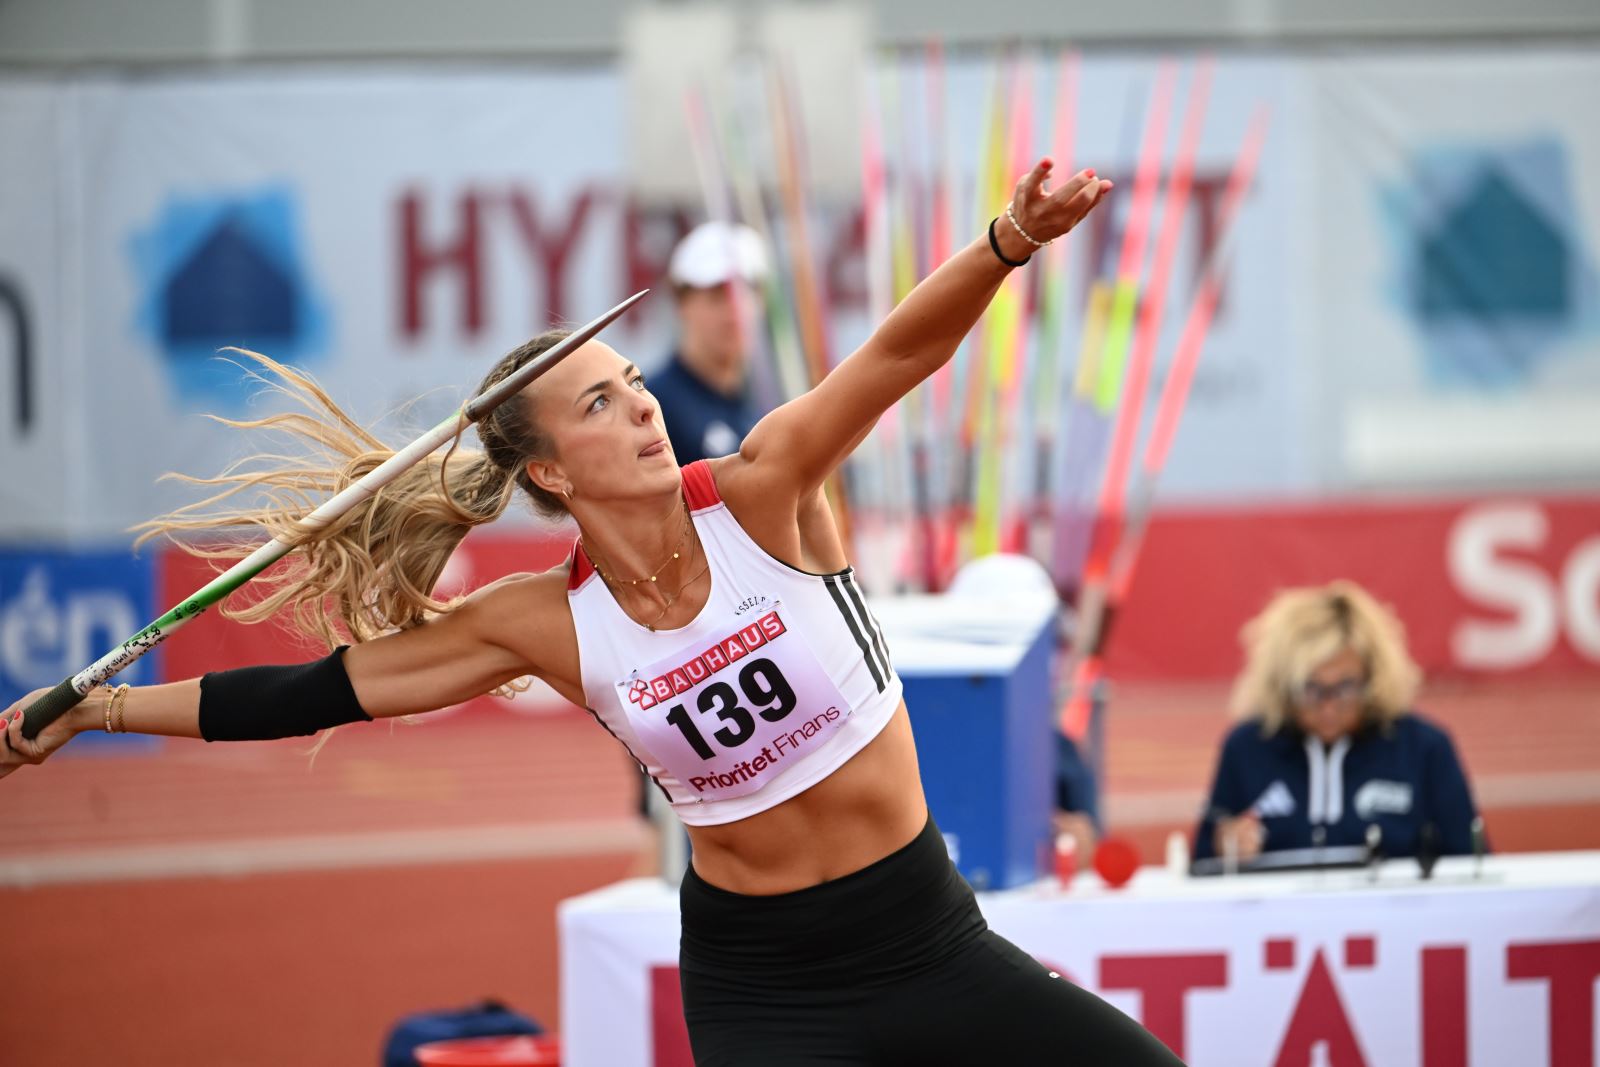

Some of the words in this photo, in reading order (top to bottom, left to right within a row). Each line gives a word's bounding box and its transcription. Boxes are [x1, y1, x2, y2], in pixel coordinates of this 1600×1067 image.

[654, 612, 785, 701] BAUHAUS
[666, 657, 797, 761] 139
[689, 746, 778, 793] Prioritet
[772, 705, 841, 758] Finans
